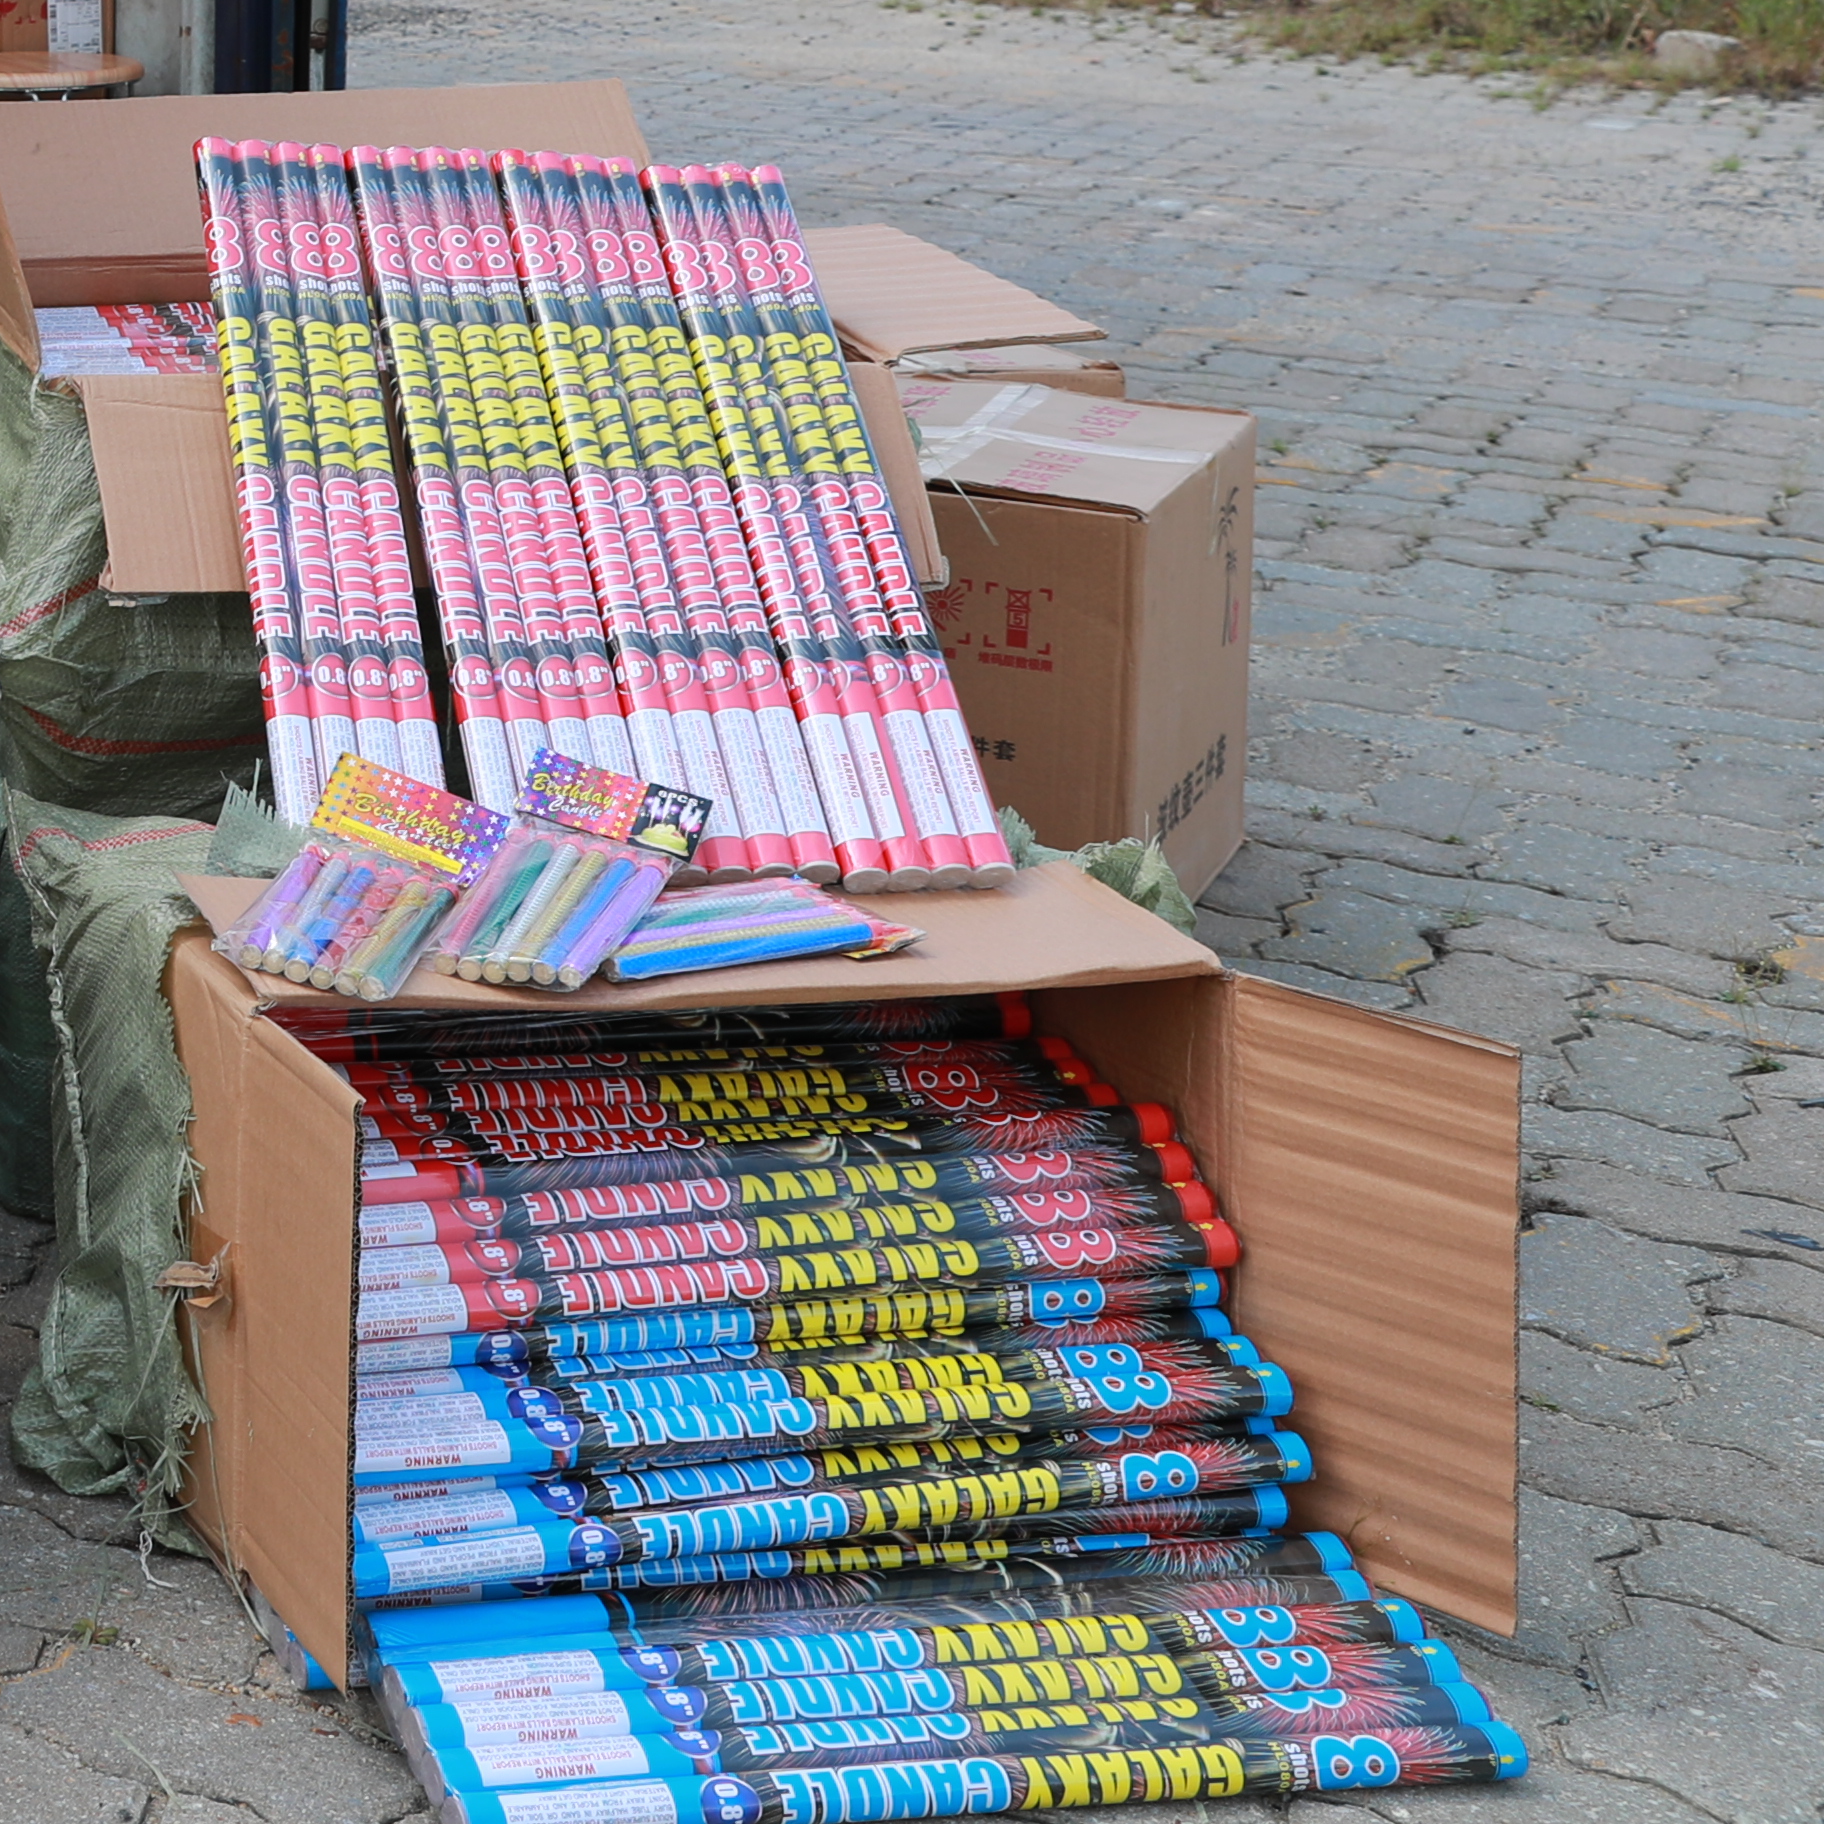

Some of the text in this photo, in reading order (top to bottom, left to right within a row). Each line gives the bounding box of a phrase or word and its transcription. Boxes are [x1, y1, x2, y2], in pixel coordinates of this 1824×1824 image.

[319, 222, 361, 277] 8
[335, 321, 398, 476] GALAXY
[361, 479, 423, 647] CANDLE
[532, 772, 616, 809] Birthday
[868, 750, 891, 798] WARNING
[959, 747, 982, 794] WARNING
[353, 791, 468, 845] Birthday
[547, 797, 604, 818] Candle
[658, 789, 700, 808] 6PCS
[404, 1453, 462, 1468] WARNING
[1119, 1449, 1200, 1502] 8
[636, 1464, 1061, 1559] GALAXY CANDLE
[534, 1763, 597, 1779] WARNING
[780, 1738, 1246, 1824] GALAXY CANDLE
[1310, 1733, 1402, 1792] 8
